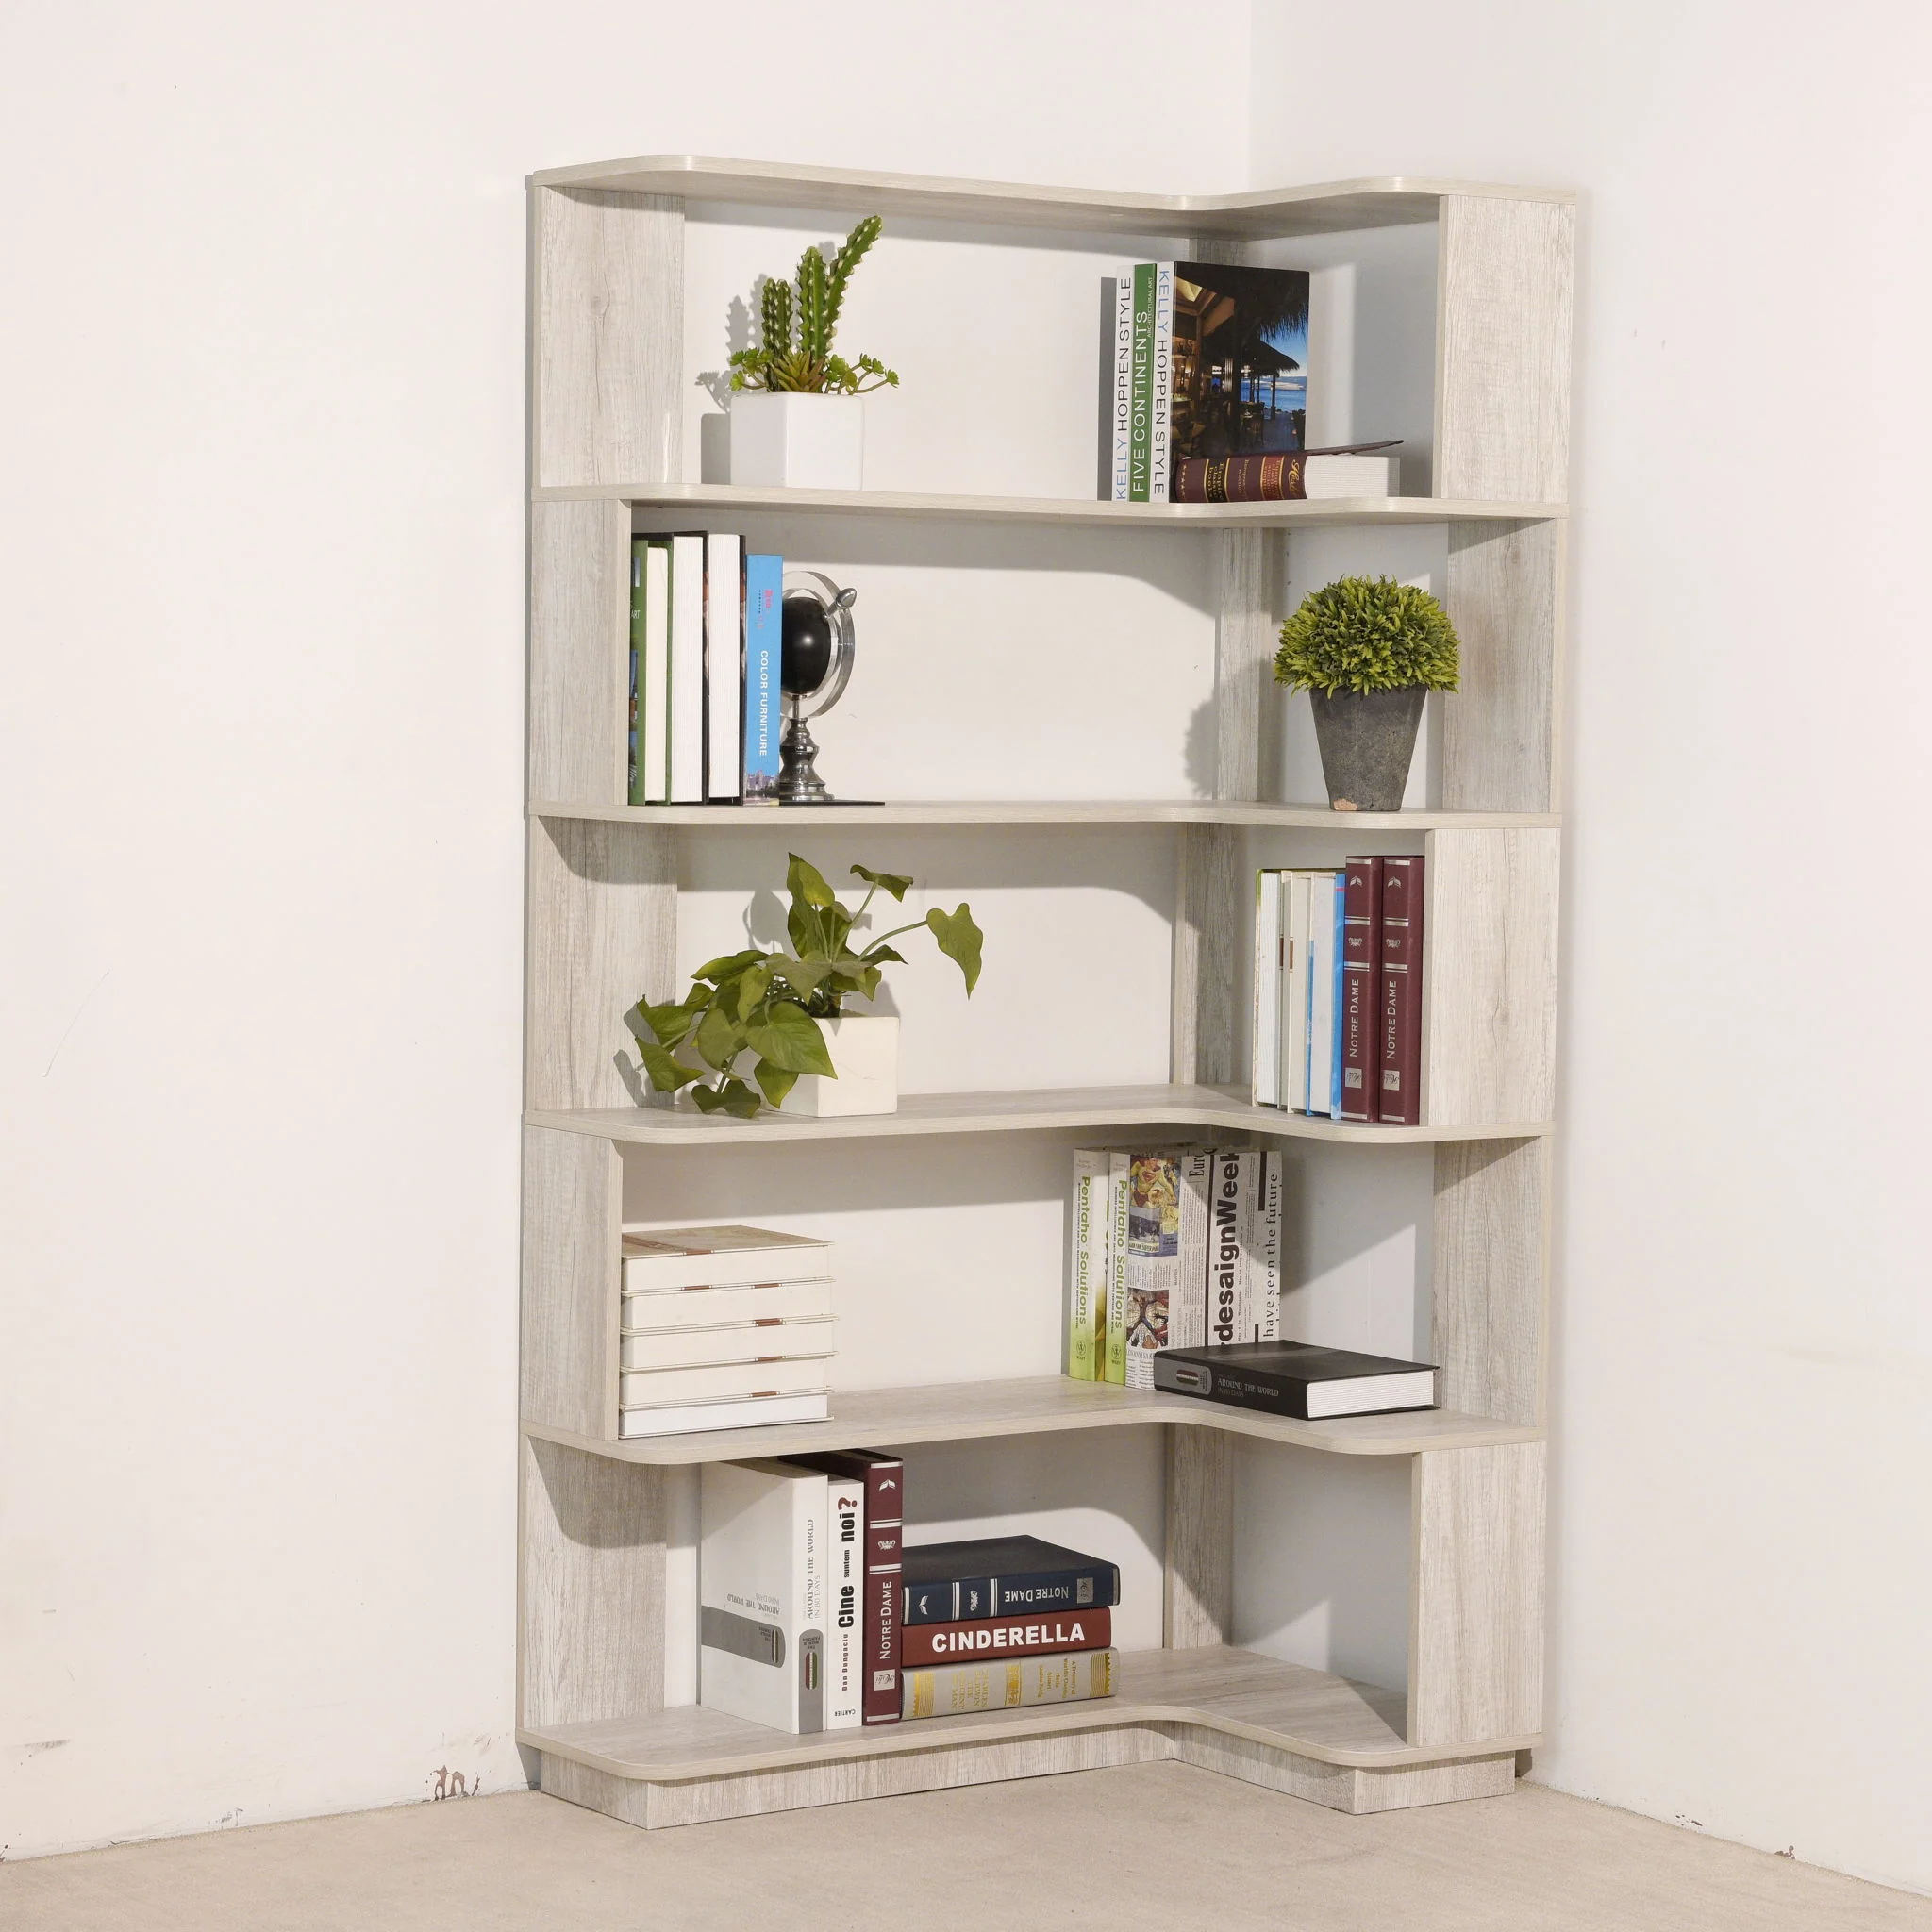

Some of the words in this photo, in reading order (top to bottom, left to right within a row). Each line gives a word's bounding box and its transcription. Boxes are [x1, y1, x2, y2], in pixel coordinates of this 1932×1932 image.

[1119, 276, 1132, 341] STYLE
[1157, 270, 1170, 333] KELLY
[1117, 347, 1130, 432] HOPPEN
[1134, 310, 1147, 442] CONTINENTS
[1156, 340, 1168, 425] HOPPEN
[1116, 438, 1128, 500] KELLY
[1133, 448, 1145, 492] FIVE
[1154, 431, 1166, 495] STYLE
[759, 692, 768, 757] FURNITURE
[1350, 978, 1359, 1013] DAME
[1387, 980, 1396, 1015] DAME
[1349, 1017, 1358, 1058] NOTRE
[1387, 1018, 1396, 1059] NOTRE
[1079, 1175, 1091, 1243] Pentaho
[1117, 1179, 1127, 1247] Pentaho
[1266, 1168, 1278, 1224] future-
[1213, 1153, 1240, 1345] desaignWeek
[1266, 1229, 1276, 1255] the
[1079, 1250, 1090, 1324] Solutions
[1115, 1255, 1126, 1329] Solutions
[1266, 1260, 1275, 1296] seen
[1263, 1301, 1274, 1337] have
[1217, 1377, 1243, 1390] AROUND
[1245, 1383, 1256, 1392] THE
[1257, 1386, 1279, 1397] WORLD
[726, 1593, 743, 1606] WORLD
[745, 1600, 756, 1609] THE
[757, 1603, 780, 1615] AROUND
[838, 1585, 855, 1628] Cine
[881, 1581, 892, 1613] DAME
[1004, 1589, 1032, 1602] DAME
[1036, 1587, 1070, 1600] NOTRE
[879, 1615, 891, 1660] NOTRE
[932, 1621, 1085, 1653] CINDERELLA
